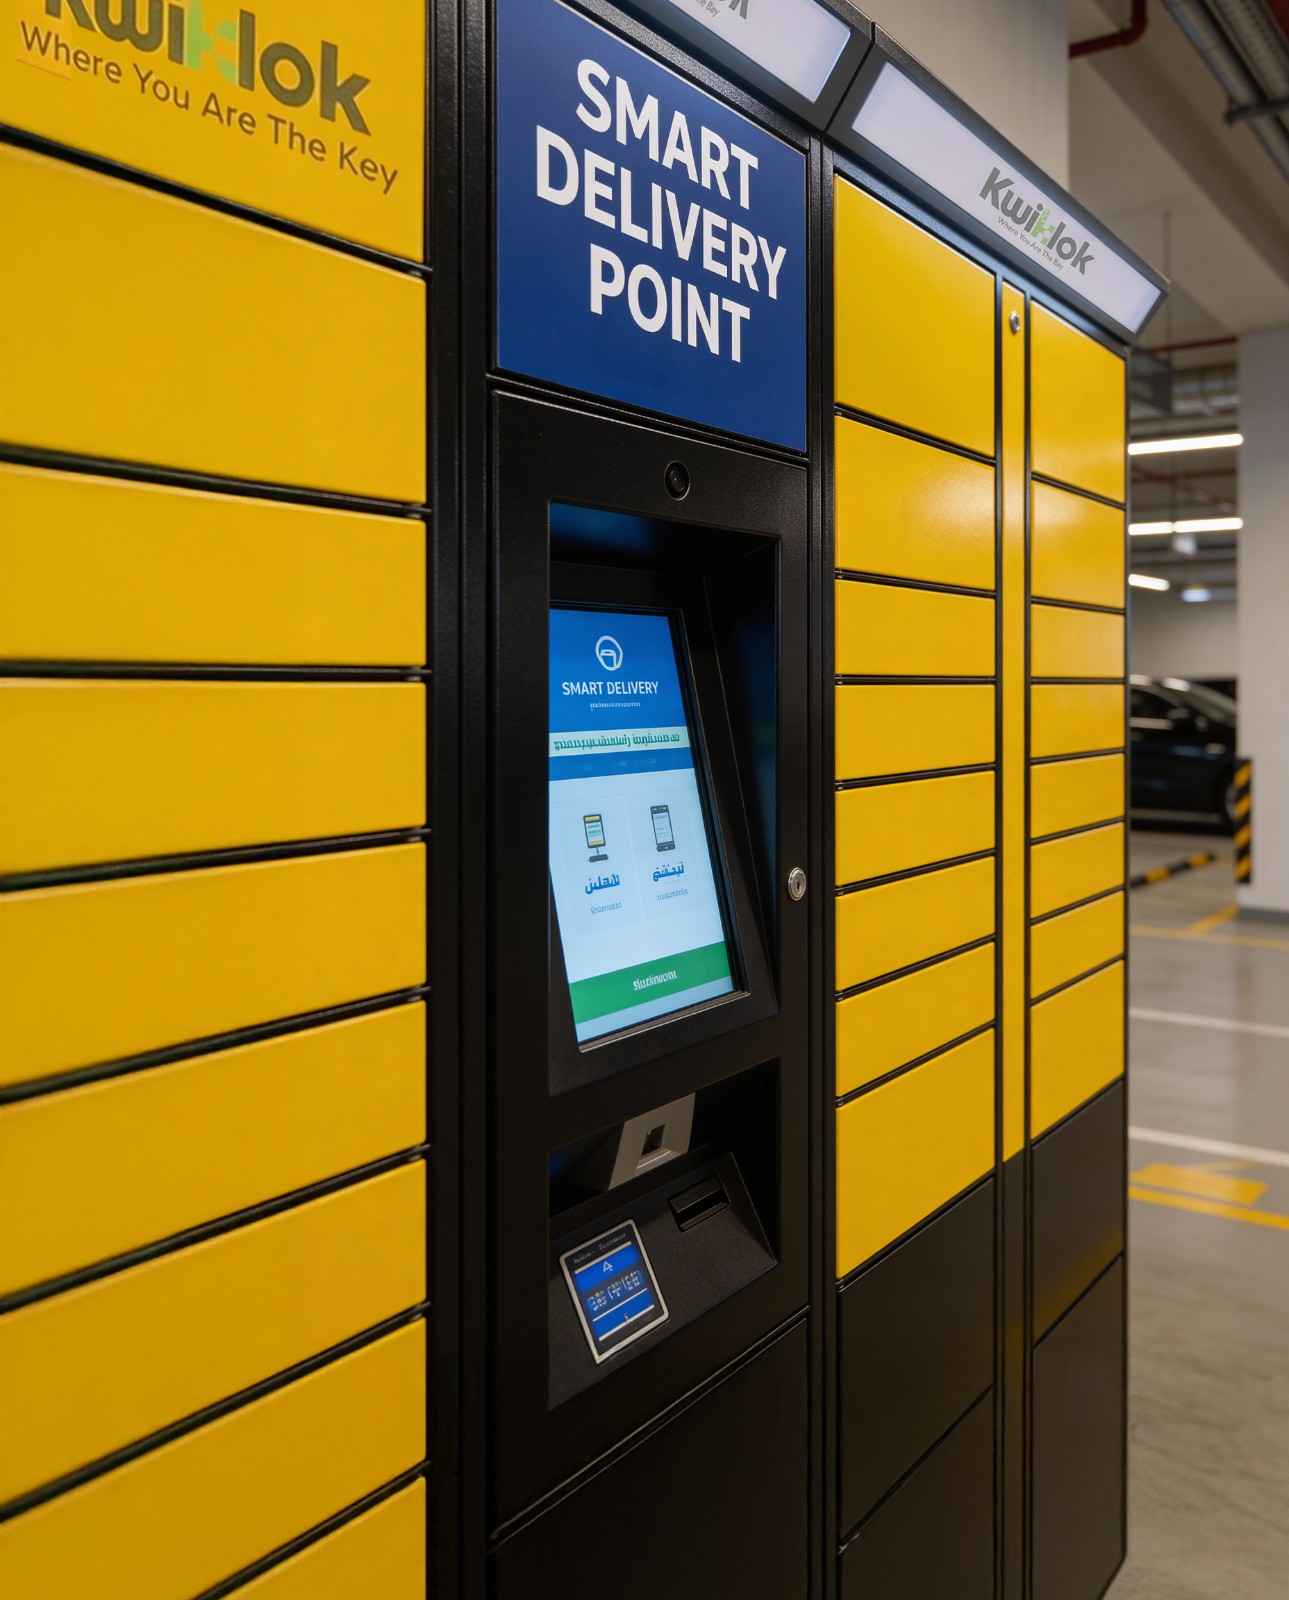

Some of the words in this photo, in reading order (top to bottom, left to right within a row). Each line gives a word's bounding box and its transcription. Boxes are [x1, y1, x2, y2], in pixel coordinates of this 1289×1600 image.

[20, 20, 122, 84] Where
[133, 63, 190, 111] You
[202, 92, 257, 135] Are
[267, 113, 327, 162] The
[339, 141, 399, 195] Key
[576, 59, 759, 210] SMART
[536, 125, 787, 300] DELIVERY
[590, 243, 751, 363] POINT
[562, 681, 603, 696] SMART
[607, 681, 659, 695] DELIVERY
